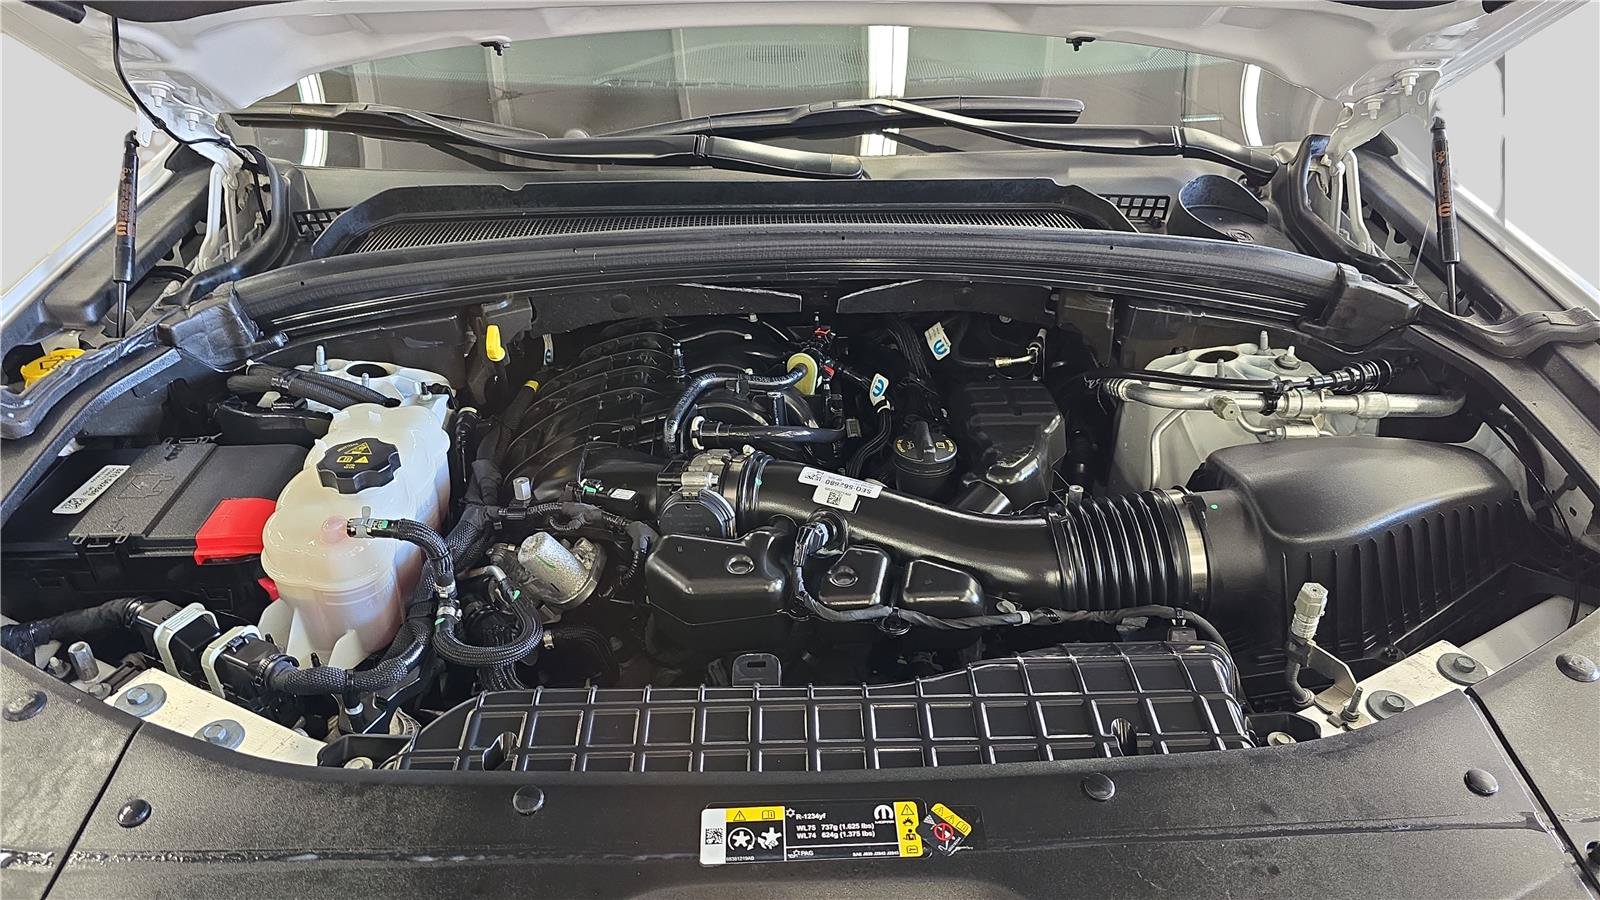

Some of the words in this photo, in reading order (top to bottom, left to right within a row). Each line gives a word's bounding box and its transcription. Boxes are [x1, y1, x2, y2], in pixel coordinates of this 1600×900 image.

[796, 812, 826, 821] R-1234yf
[796, 824, 816, 832] WL75
[821, 824, 838, 832] 737g
[839, 823, 860, 832] (1.625
[861, 822, 875, 831] lbs)
[796, 832, 817, 840] WL74
[821, 831, 839, 840] 624g
[839, 830, 861, 839] (1.375
[861, 830, 875, 839] lbs)
[800, 849, 814, 857] PAG
